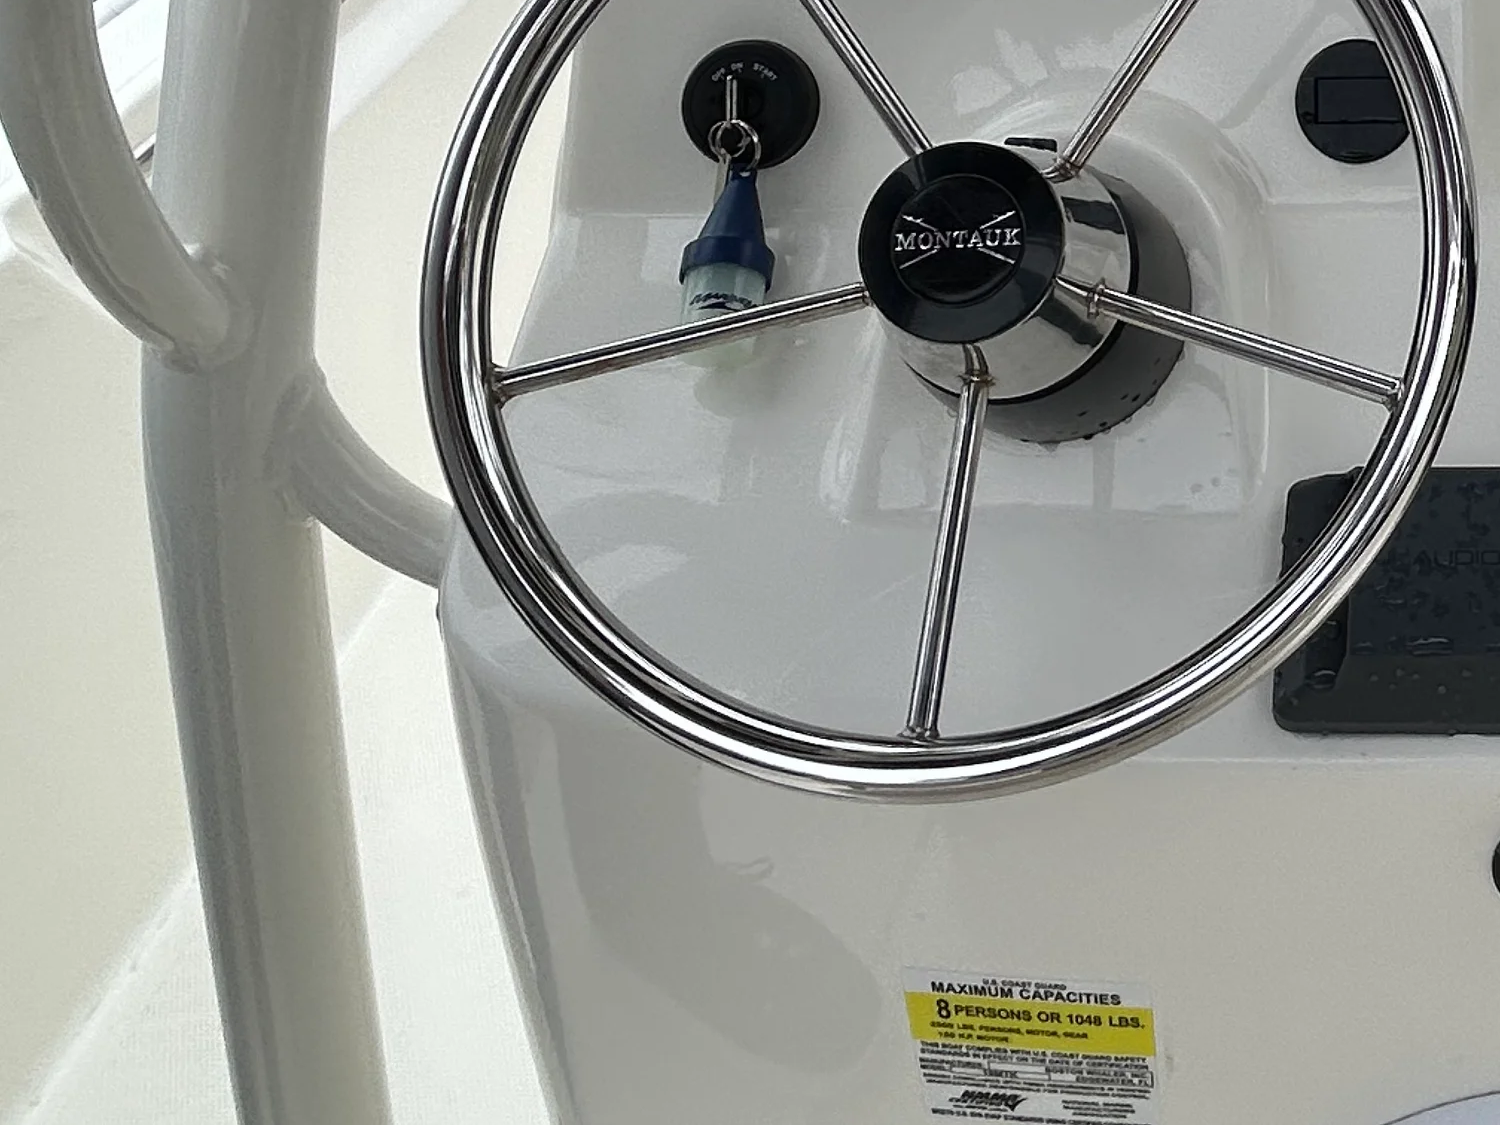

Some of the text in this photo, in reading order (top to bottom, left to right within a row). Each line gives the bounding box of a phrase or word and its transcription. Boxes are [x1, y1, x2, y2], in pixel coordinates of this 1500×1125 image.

[894, 228, 1022, 251] MONTAUK
[930, 981, 1121, 1006] MAXIMUM CAPACITIES
[936, 998, 1145, 1029] 8 PERSONS OR 1048 LBS.
